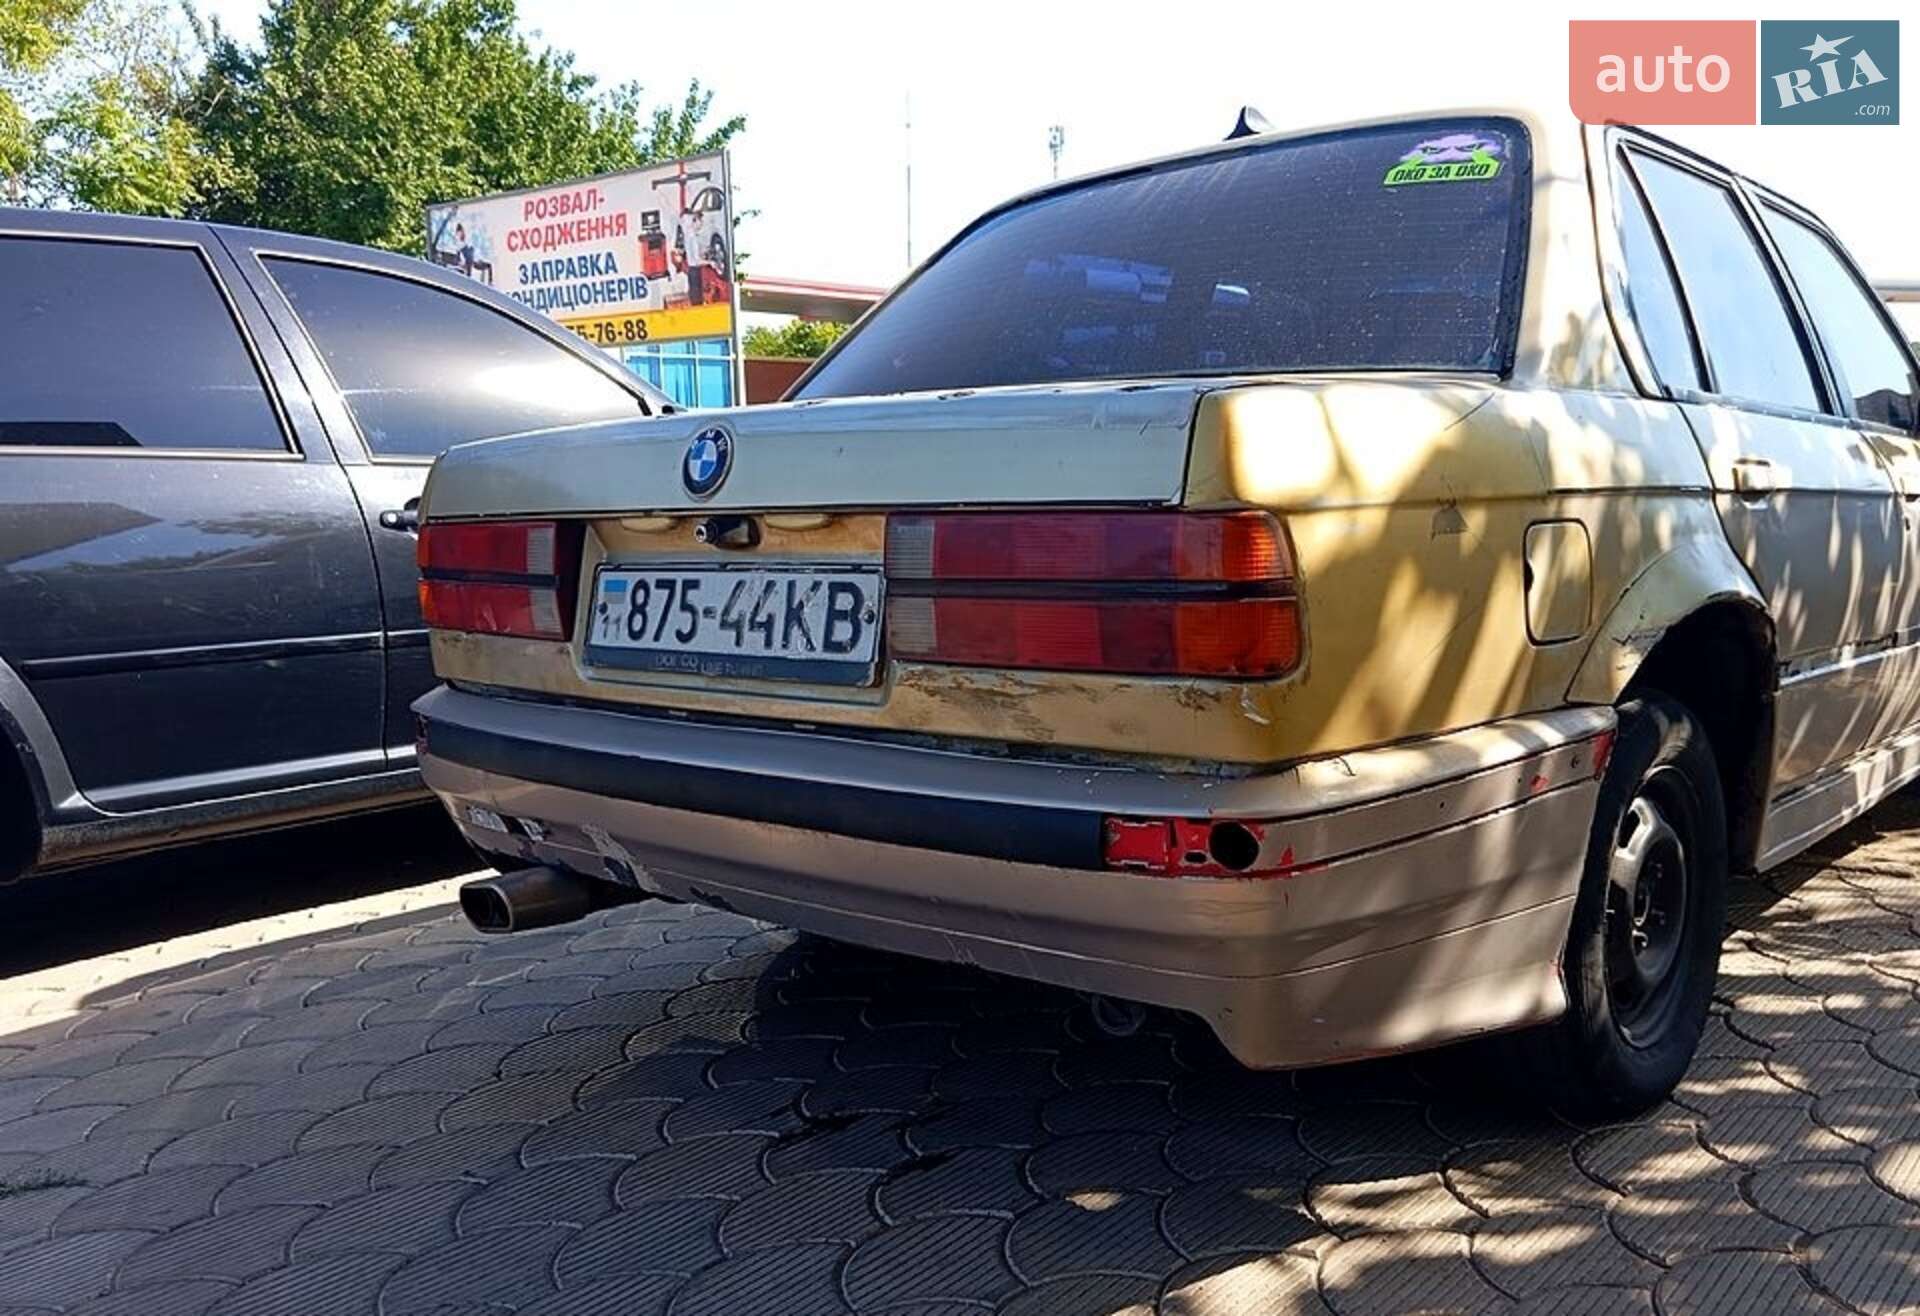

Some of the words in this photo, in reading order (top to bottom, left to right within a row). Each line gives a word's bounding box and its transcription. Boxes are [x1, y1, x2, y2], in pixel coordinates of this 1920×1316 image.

[523, 188, 605, 221] РОЗВАЛ-
[506, 213, 628, 252] СХОДЖЕННЯ
[518, 251, 618, 285] ЗАПРАВКА
[507, 276, 649, 313] ОНДИЦІОНЕРІВ
[566, 318, 648, 343] 5-76-88
